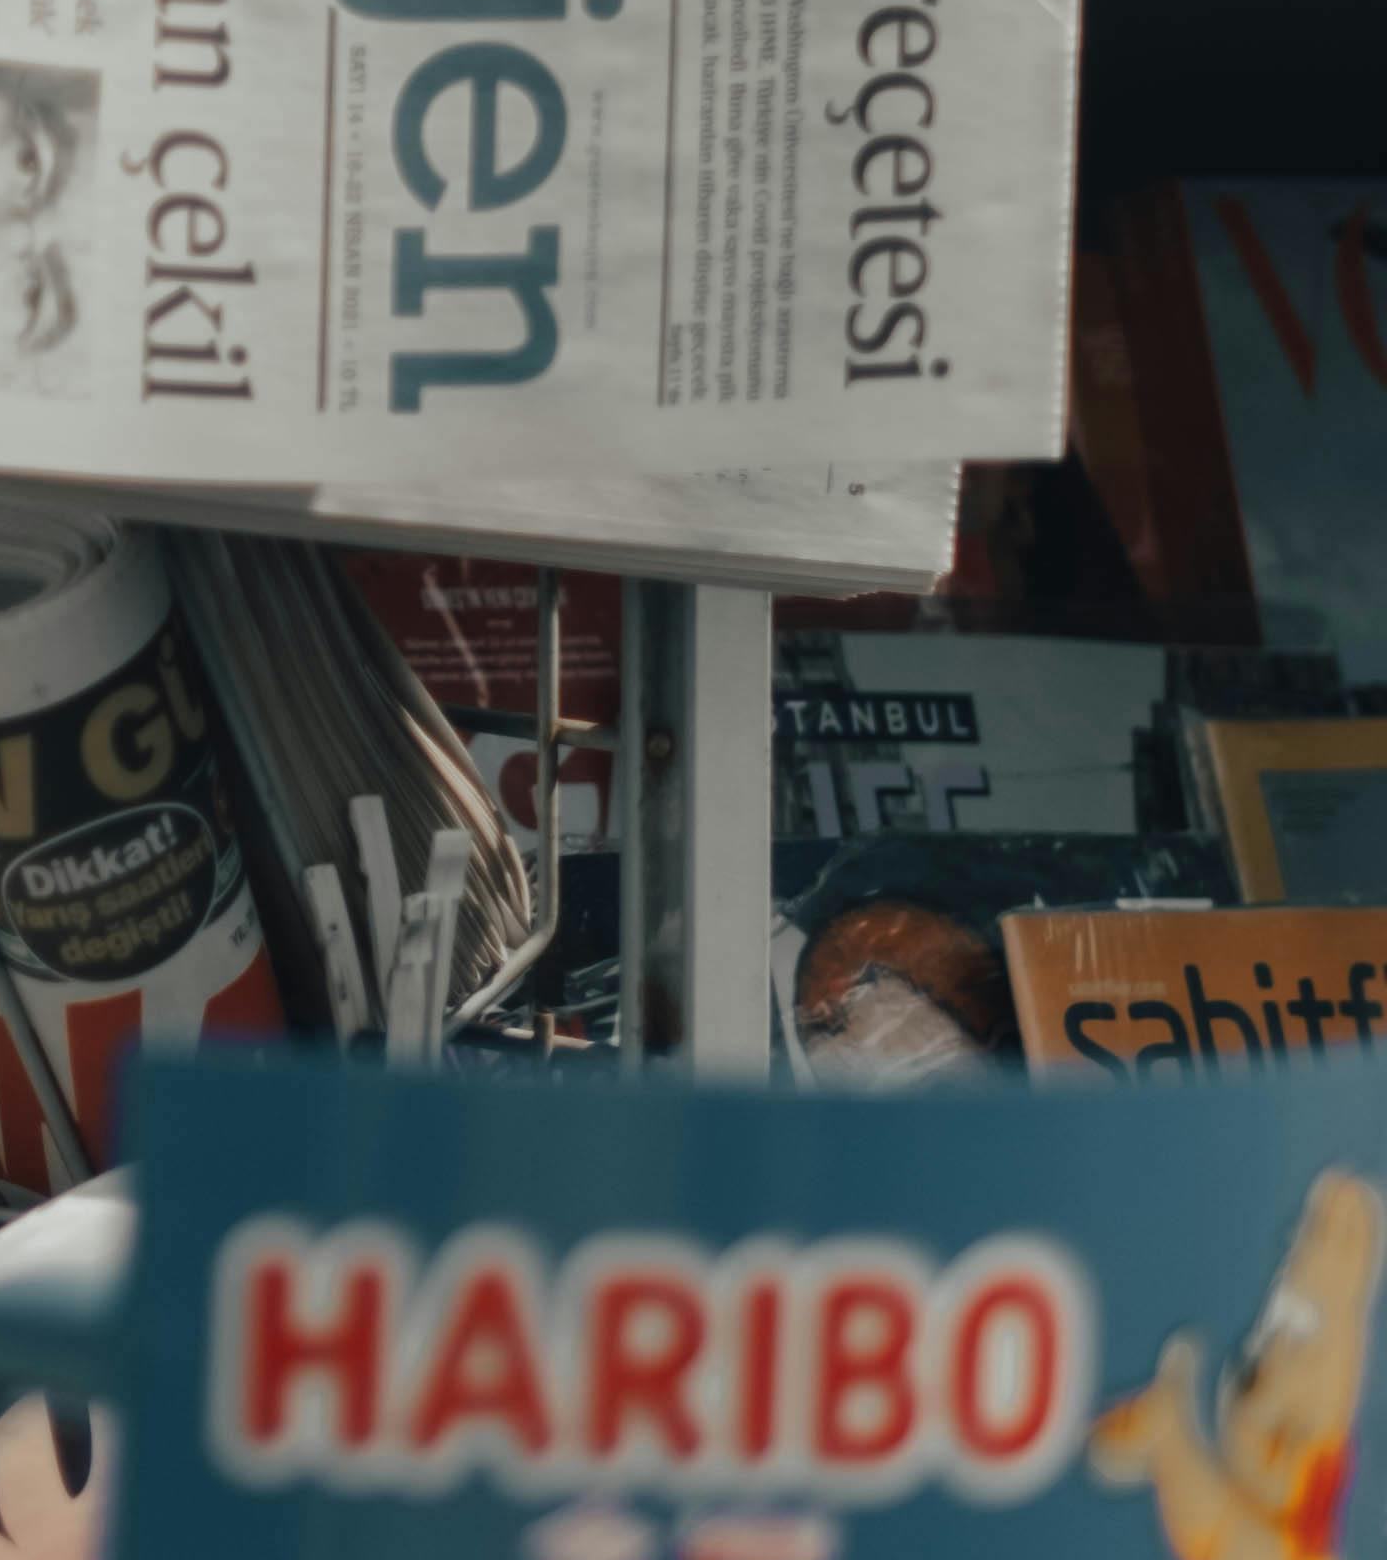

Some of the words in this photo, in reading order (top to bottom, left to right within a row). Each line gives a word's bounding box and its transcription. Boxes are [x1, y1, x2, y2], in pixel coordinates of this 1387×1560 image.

[121, 129, 256, 404] çekil
[25, 817, 182, 902] Dikkat!
[95, 838, 211, 911] saatleri
[60, 892, 194, 970] değişti!
[227, 1232, 1077, 1480] HARIBO
